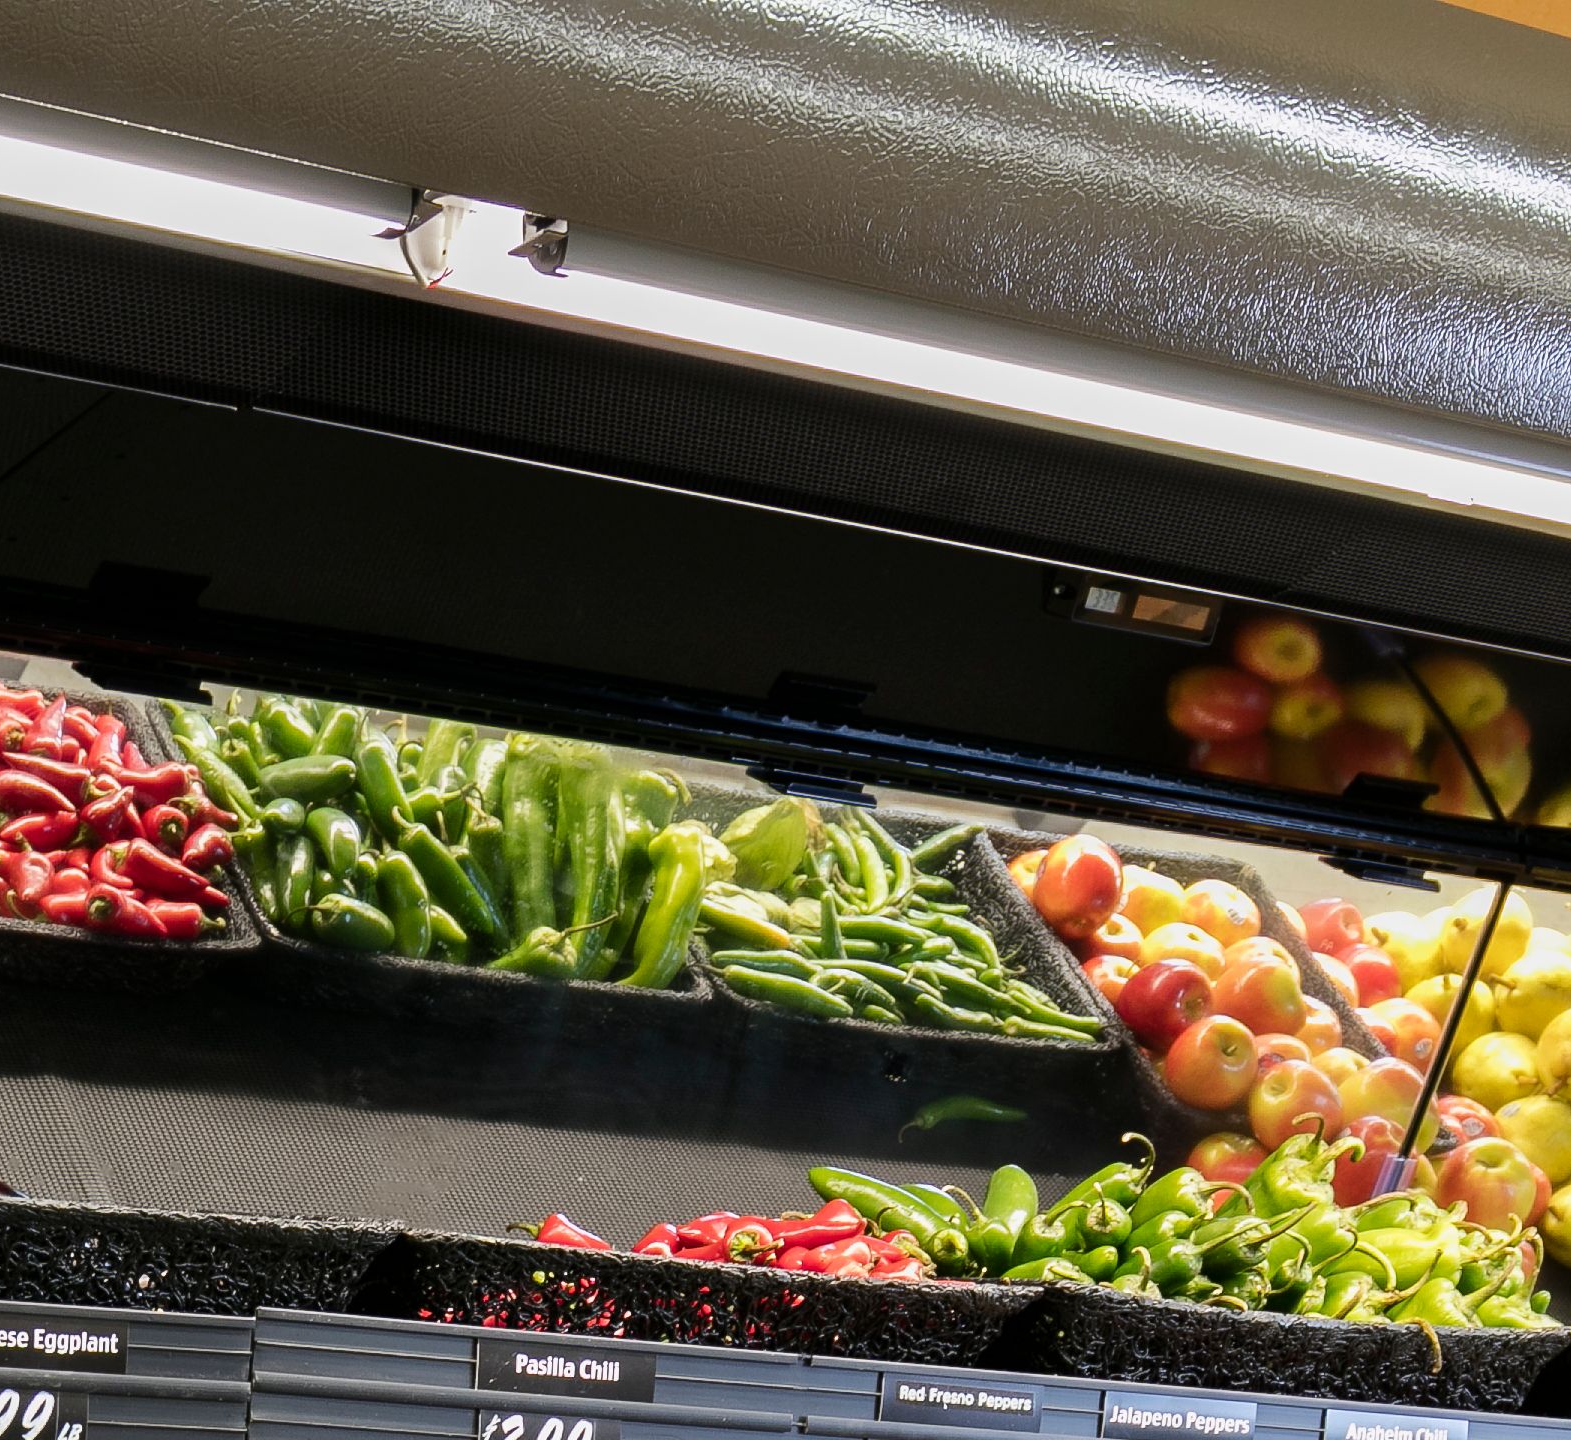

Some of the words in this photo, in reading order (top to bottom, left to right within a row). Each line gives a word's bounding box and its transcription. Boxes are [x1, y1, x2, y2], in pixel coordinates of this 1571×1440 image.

[34, 1327, 119, 1357] Eggplant
[515, 1354, 577, 1382] Pasilla
[580, 1357, 620, 1383] Chili
[900, 1385, 924, 1402] Red
[929, 1386, 975, 1409] Fresno
[978, 1391, 1031, 1414] Peppers
